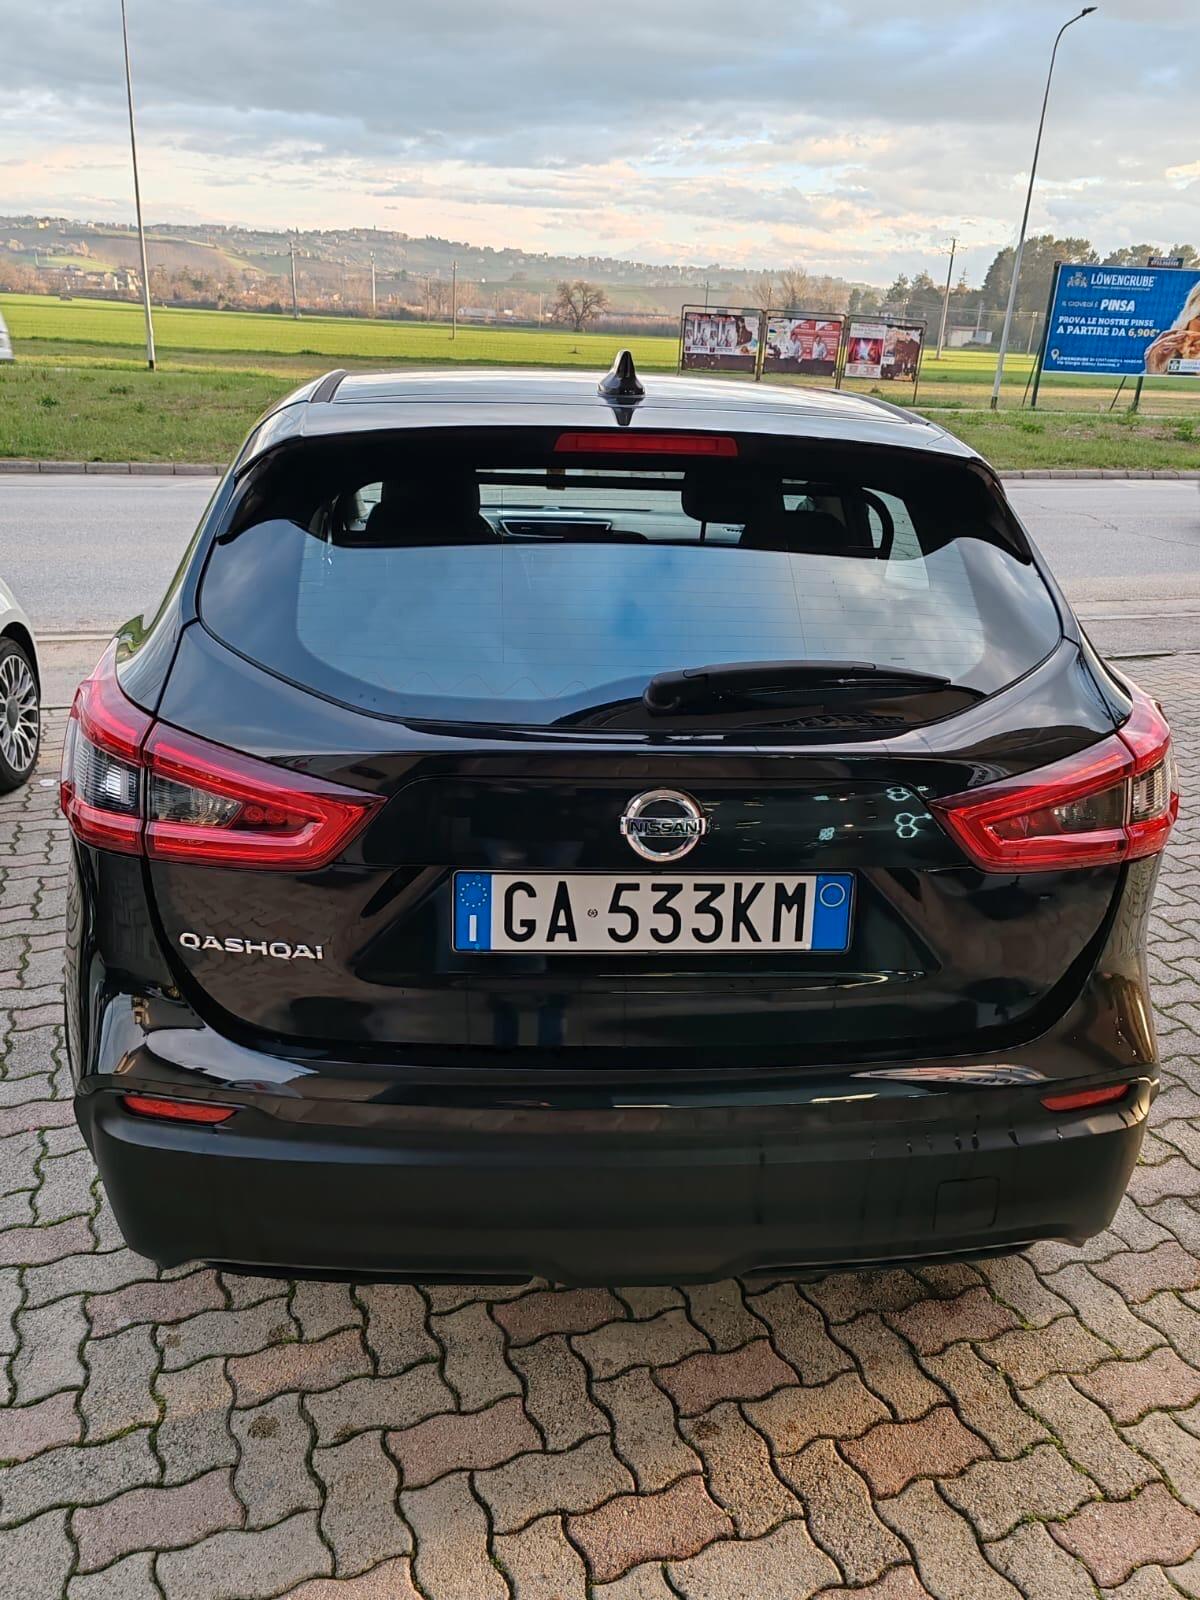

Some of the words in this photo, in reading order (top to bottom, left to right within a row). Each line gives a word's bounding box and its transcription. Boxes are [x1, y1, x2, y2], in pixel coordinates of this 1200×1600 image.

[1091, 271, 1155, 287] LÖWENGRUBE
[1100, 299, 1136, 312] PINSA
[1058, 316, 1086, 324] PROVA
[1087, 317, 1097, 325] LE
[1098, 318, 1129, 326] NOSTRE
[1130, 319, 1155, 327] PINSE
[1056, 325, 1065, 334] A
[1066, 325, 1110, 336] PARTIRE
[1111, 327, 1126, 337] DA
[630, 821, 698, 835] NISSAN
[503, 880, 578, 944] GA
[607, 881, 809, 944] 533KM
[468, 914, 478, 942] I
[179, 932, 324, 960] QASHQAI
